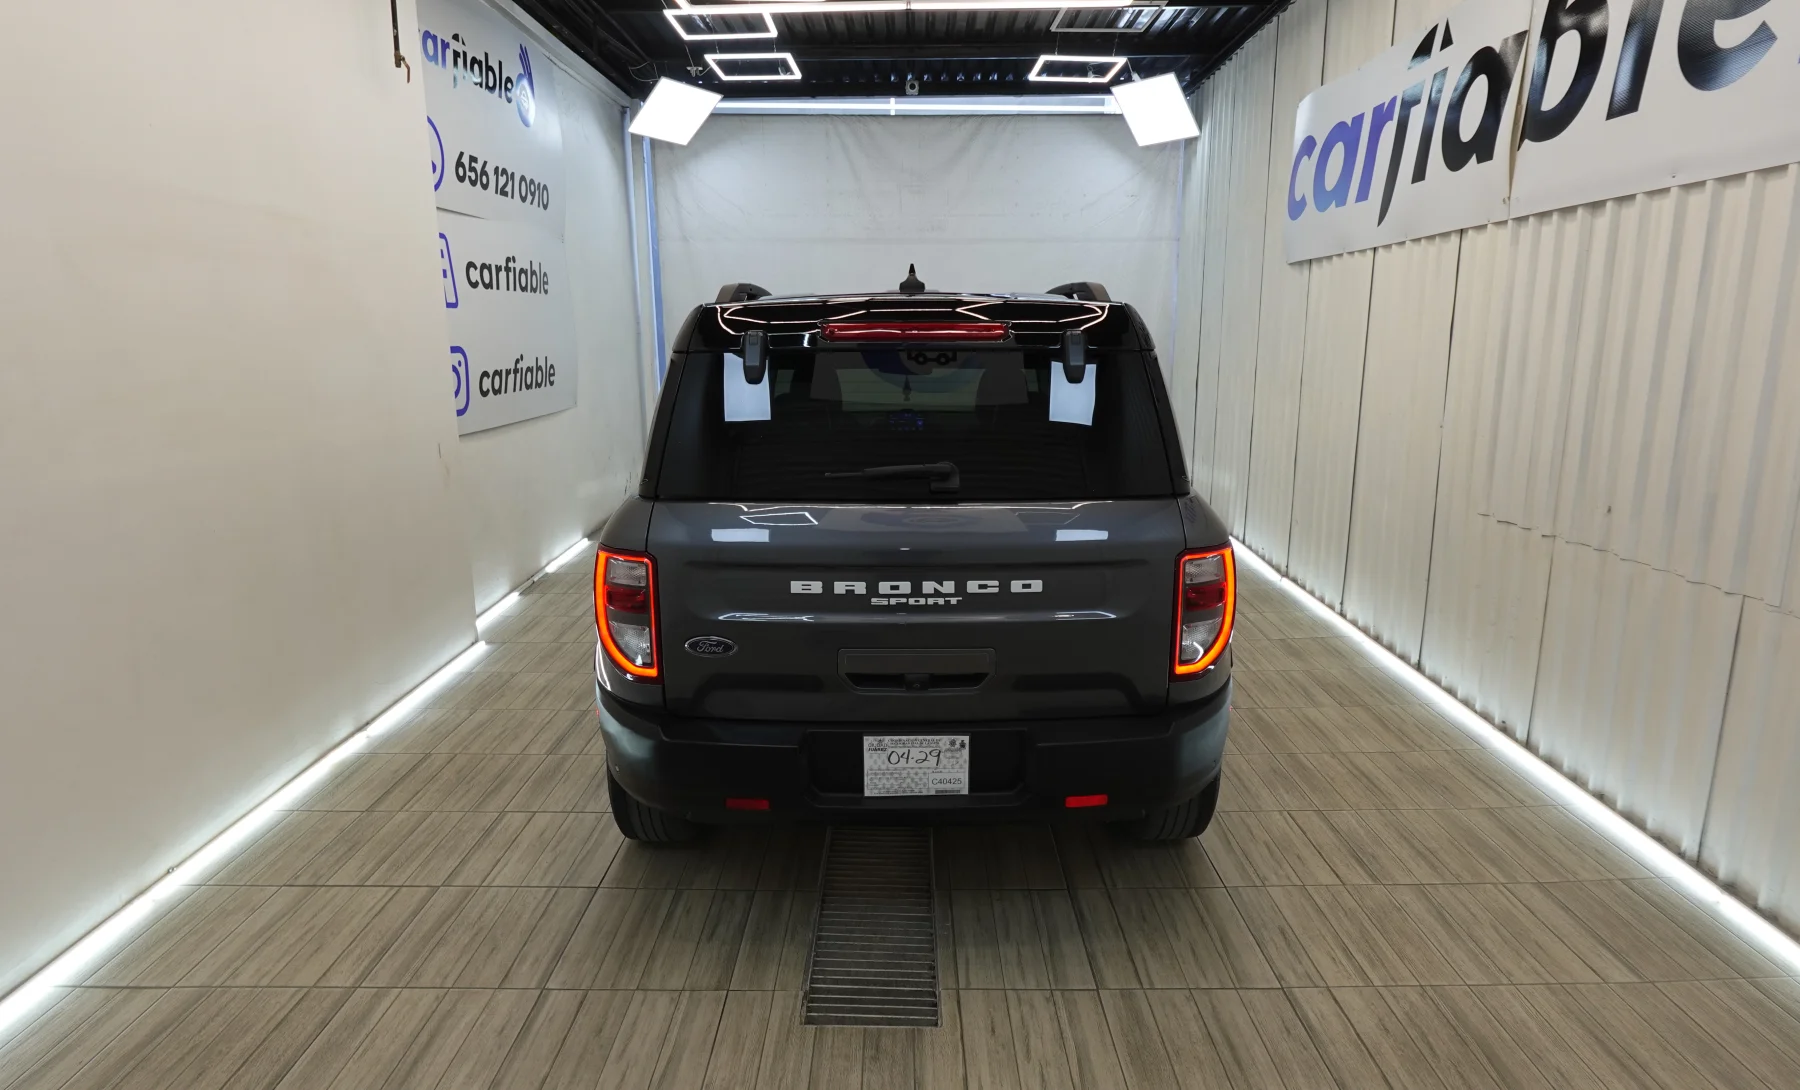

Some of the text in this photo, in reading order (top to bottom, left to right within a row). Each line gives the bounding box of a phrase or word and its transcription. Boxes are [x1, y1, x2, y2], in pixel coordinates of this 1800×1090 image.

[422, 30, 514, 103] arfiable
[455, 151, 549, 210] 656 121 0910
[465, 255, 549, 295] carfiable
[479, 354, 556, 398] carfiable
[790, 579, 1043, 595] BRONCO
[870, 597, 962, 606] SPORT
[697, 641, 724, 652] Ford
